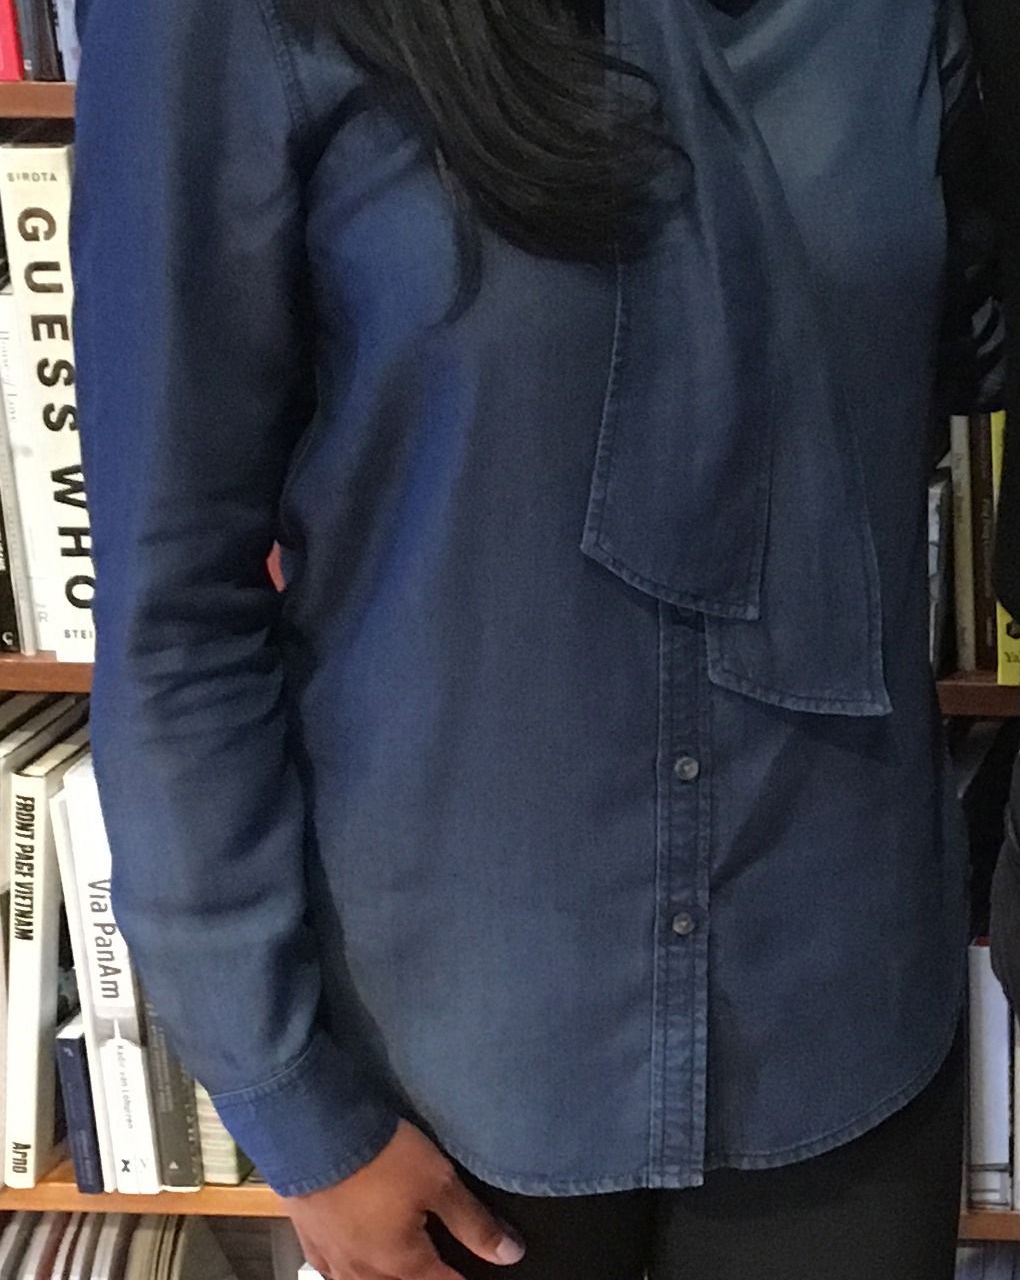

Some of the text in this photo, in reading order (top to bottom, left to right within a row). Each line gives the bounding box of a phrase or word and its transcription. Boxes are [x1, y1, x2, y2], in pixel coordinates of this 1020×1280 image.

[8, 172, 57, 182] SIROTA
[18, 207, 96, 609] GUESS WHO
[11, 795, 35, 1174] FRONT PAGE VIETNAM Arno
[88, 878, 123, 999] Via PanAm
